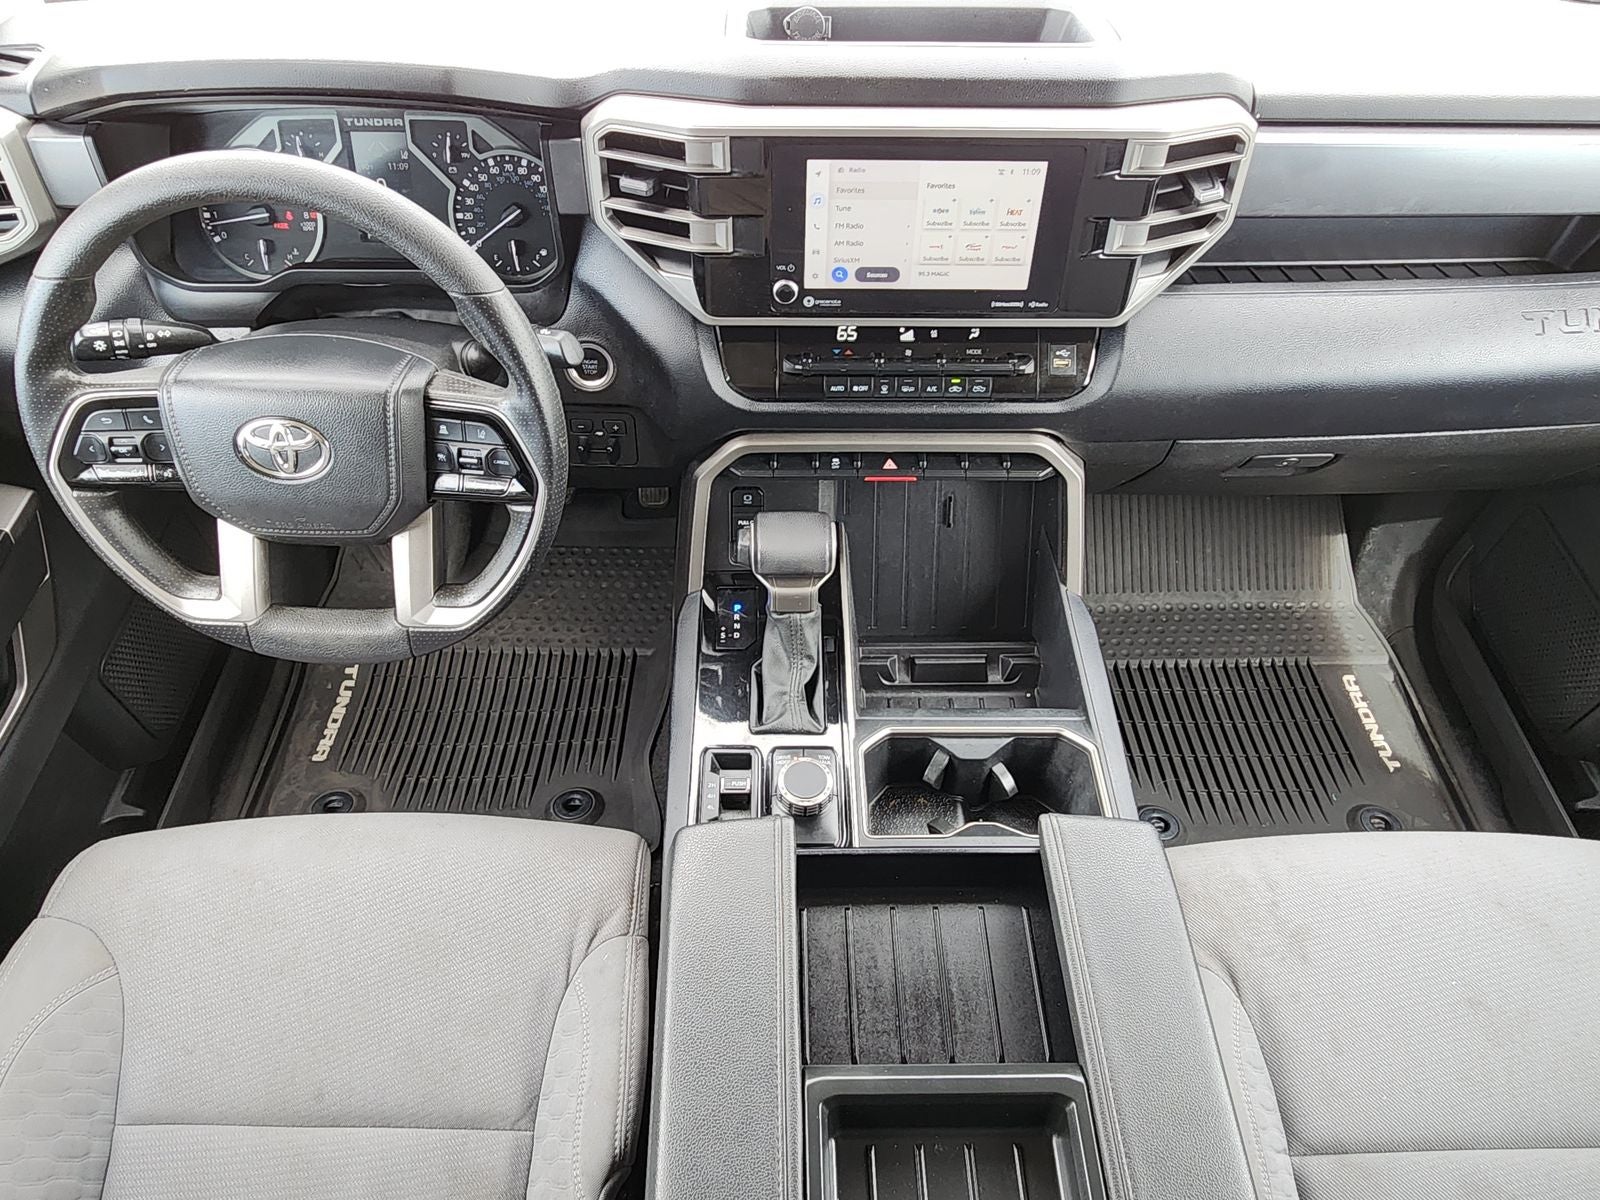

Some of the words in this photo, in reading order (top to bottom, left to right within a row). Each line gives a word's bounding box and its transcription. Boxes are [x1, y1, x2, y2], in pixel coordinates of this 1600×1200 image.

[344, 117, 403, 126] TUNDRA
[387, 162, 409, 170] 11:09
[503, 164, 514, 172] 70
[489, 166, 500, 175] 60
[517, 167, 528, 175] 80
[1022, 168, 1042, 176] 11:09
[478, 174, 488, 182] 50
[531, 174, 541, 182] 90
[468, 184, 479, 192] 40
[926, 182, 956, 190] Favorites
[465, 198, 475, 206] 30
[213, 211, 218, 219] 1
[464, 212, 474, 220] 20
[467, 226, 476, 235] 10
[221, 231, 228, 239] 0
[1521, 307, 1600, 336] TU
[836, 326, 858, 341] 65
[312, 664, 359, 762] TUNDRA
[1342, 674, 1402, 773] TUNDRA
